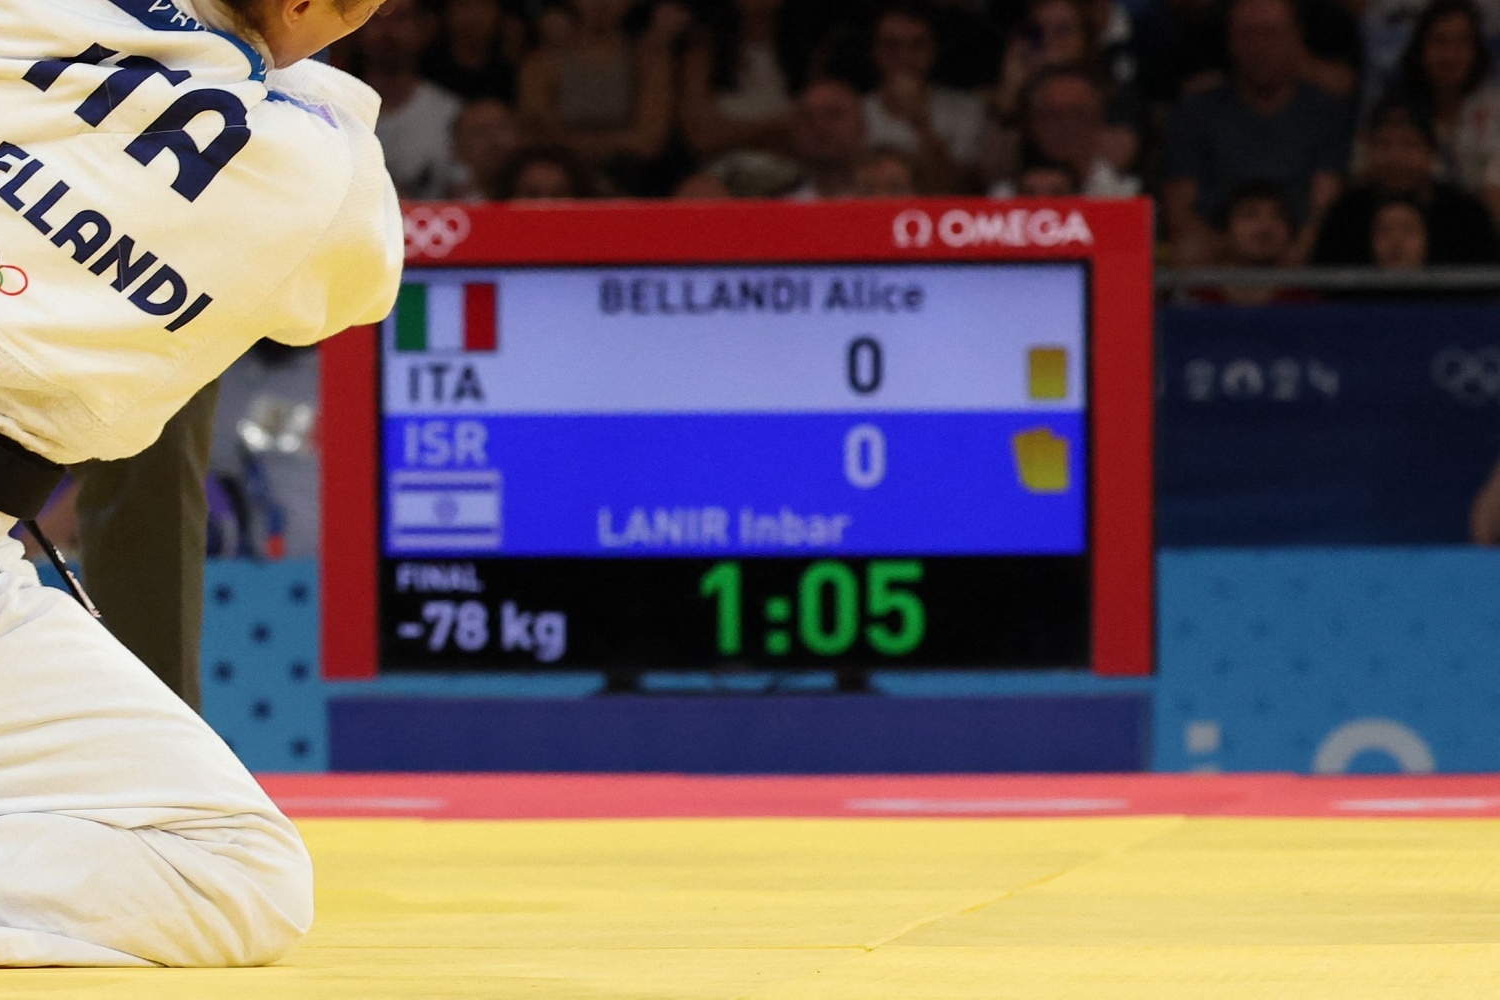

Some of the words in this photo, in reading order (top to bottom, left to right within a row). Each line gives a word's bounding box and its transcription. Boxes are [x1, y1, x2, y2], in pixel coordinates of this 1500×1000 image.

[21, 42, 251, 202] ITA
[938, 209, 1093, 248] OMEGA
[599, 279, 812, 315] BELLANDI
[828, 279, 924, 314] Alice
[409, 363, 485, 402] ITA
[845, 336, 884, 396] 0
[1184, 357, 1341, 401] 2024
[404, 421, 489, 466] ISR
[843, 424, 886, 490] 0
[598, 509, 727, 547] LANIR
[740, 508, 852, 548] Inbar
[397, 564, 484, 594] FINAL
[701, 561, 927, 655] 1:05
[398, 605, 490, 652] -78
[501, 602, 567, 662] kg
